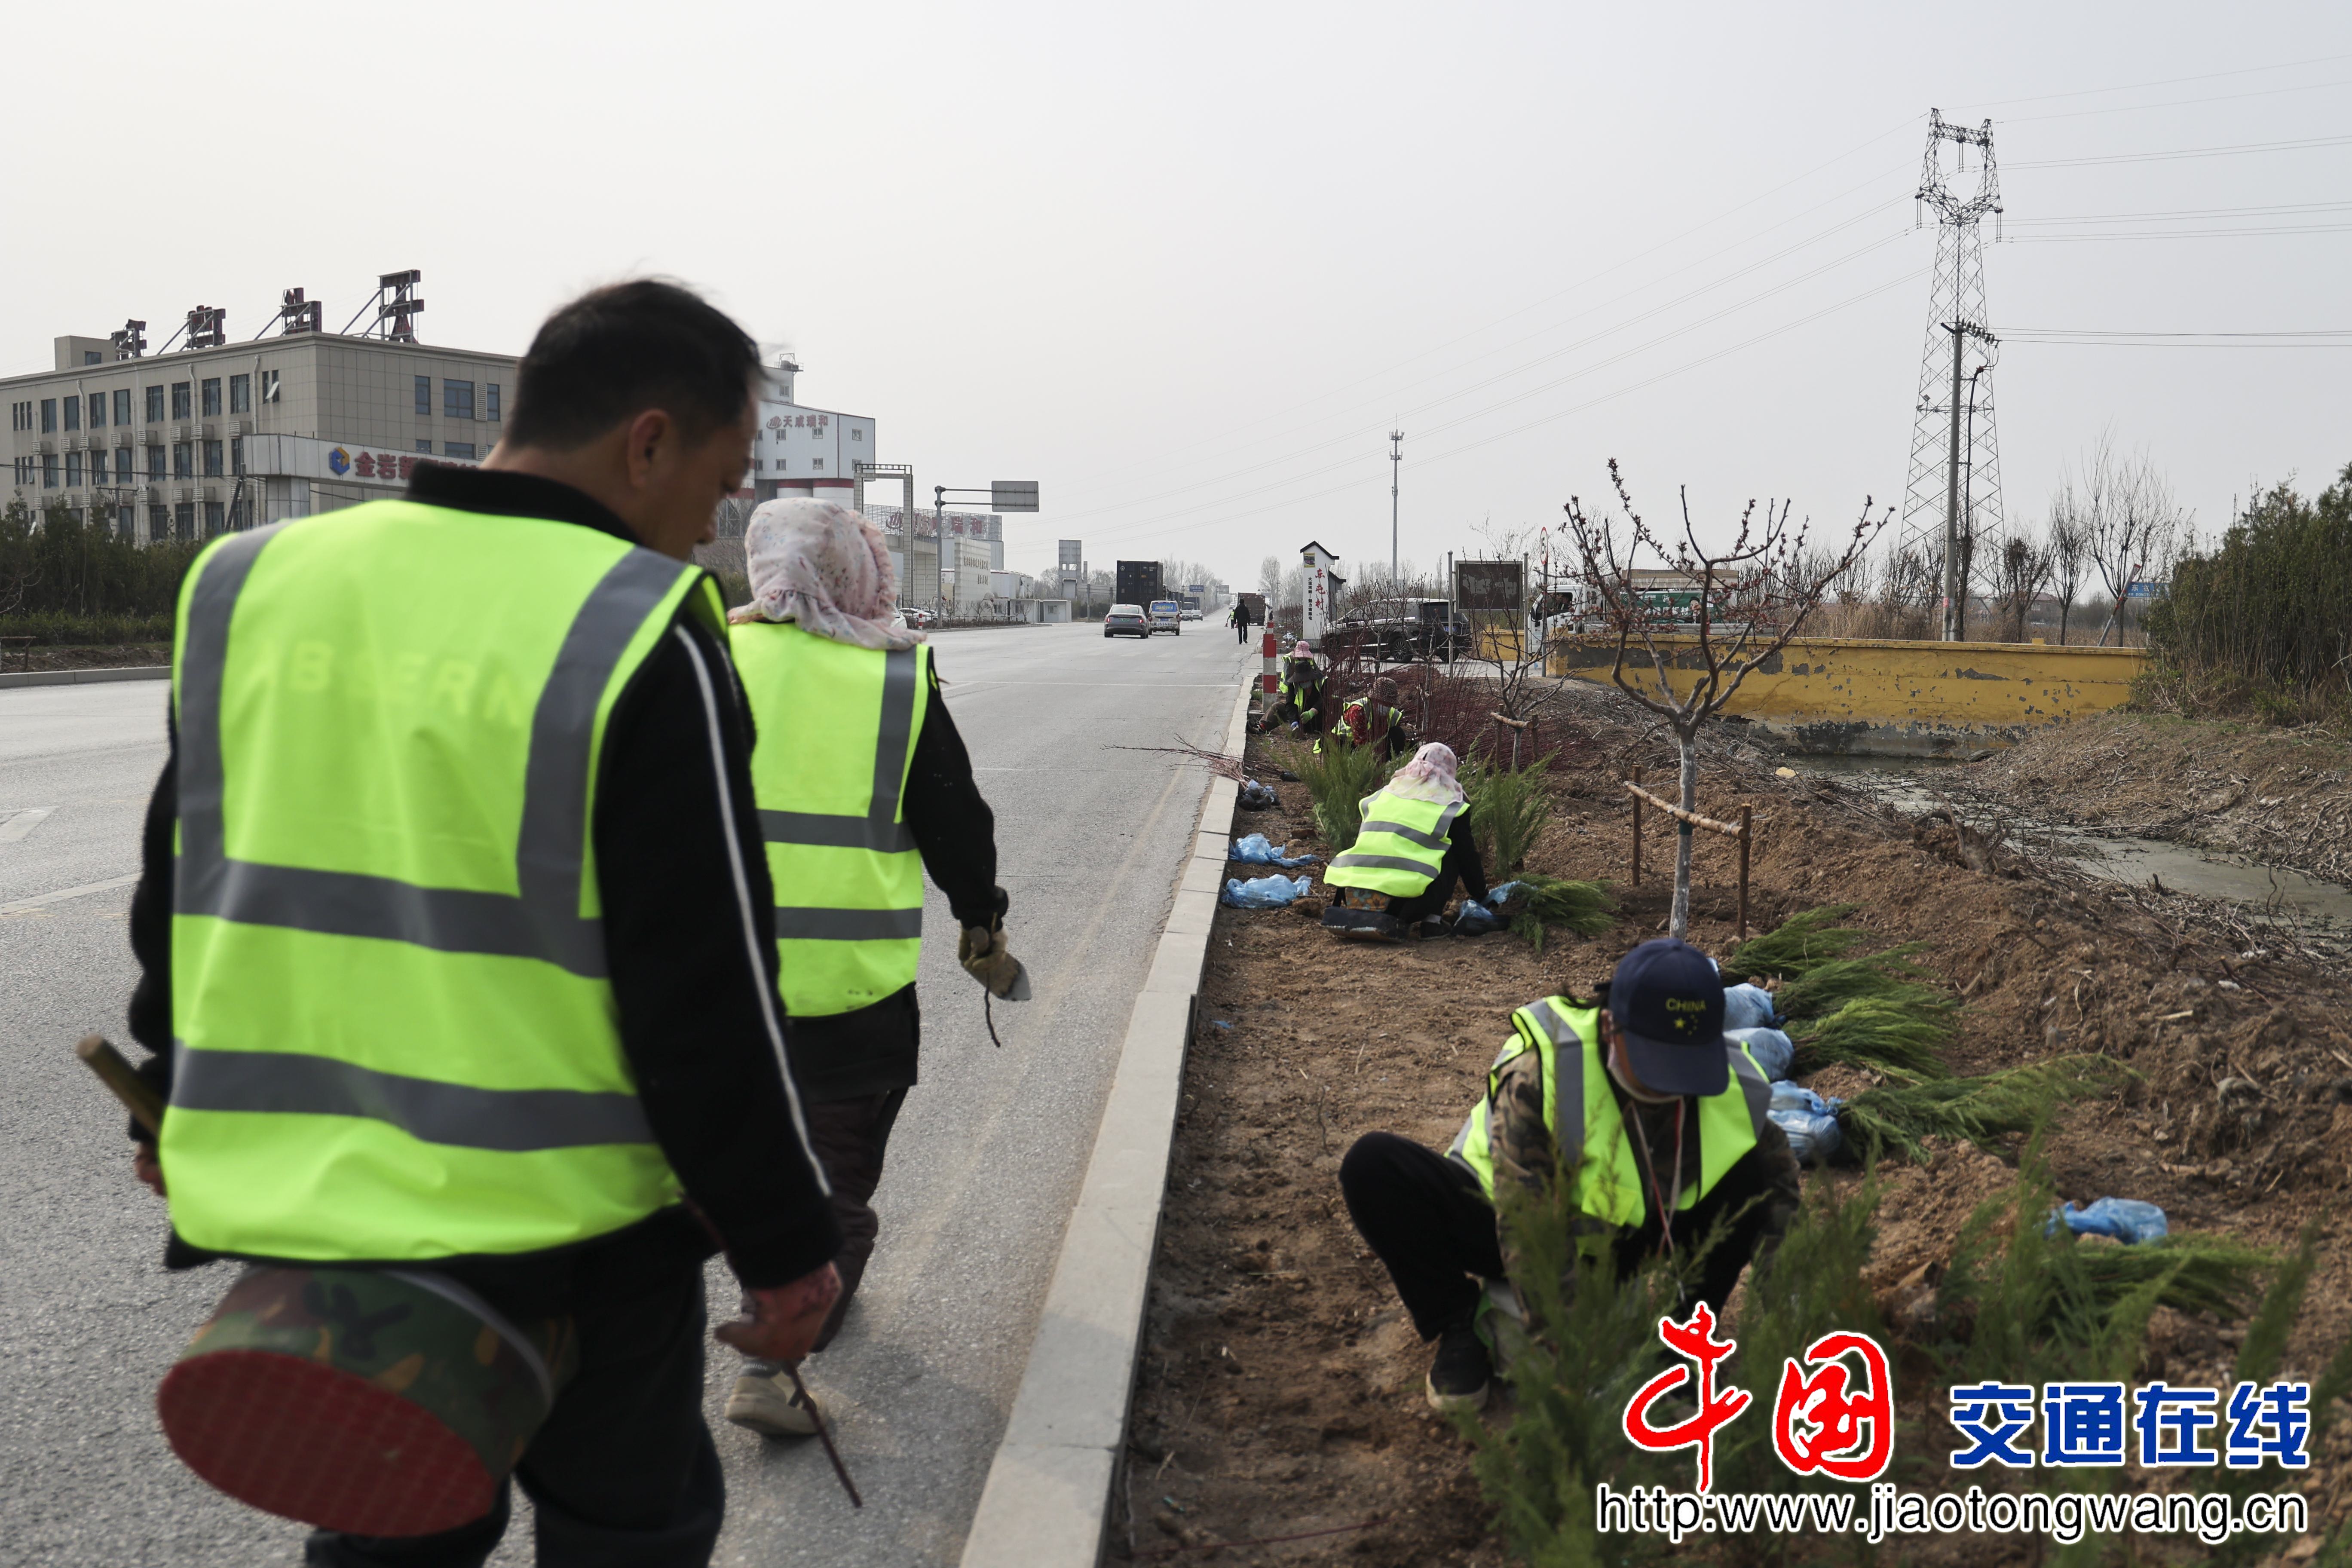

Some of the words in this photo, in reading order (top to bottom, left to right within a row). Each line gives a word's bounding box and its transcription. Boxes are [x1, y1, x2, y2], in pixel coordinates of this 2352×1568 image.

[783, 414, 828, 428] 天成瑞和
[1666, 998, 1706, 1012] CHINA
